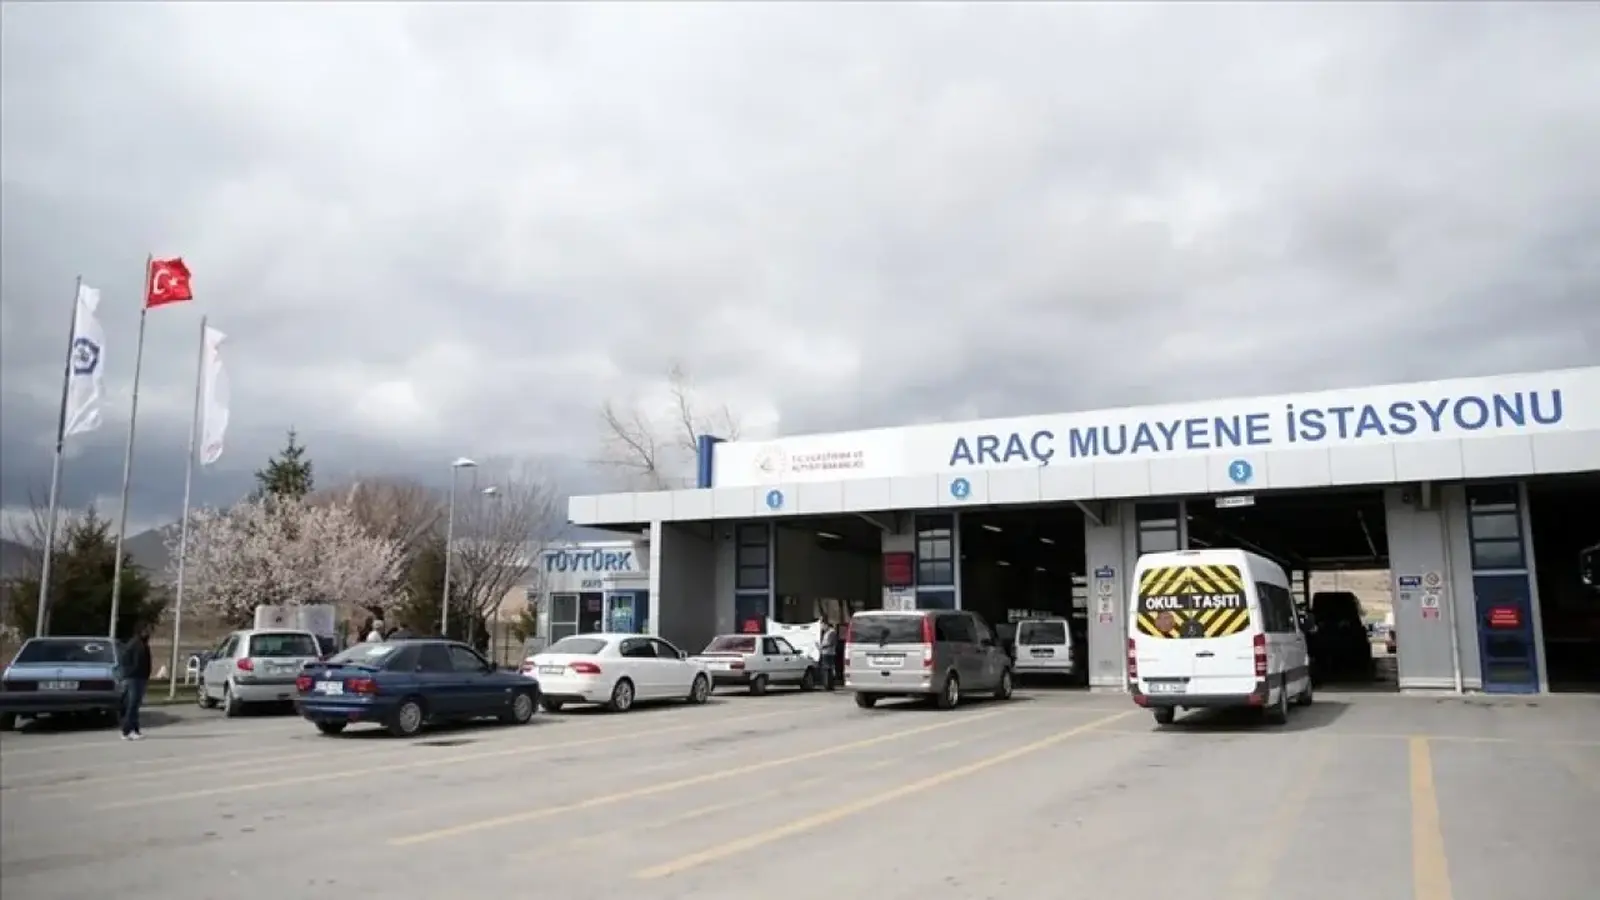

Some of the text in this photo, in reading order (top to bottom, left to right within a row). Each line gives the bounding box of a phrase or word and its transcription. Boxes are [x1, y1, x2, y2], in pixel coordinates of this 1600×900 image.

[949, 389, 1563, 466] ARAÇ MUAYENE İSTASYONU
[1235, 464, 1245, 479] 3
[545, 549, 632, 572] TÜVTÜRK
[1145, 596, 1184, 610] OKUL
